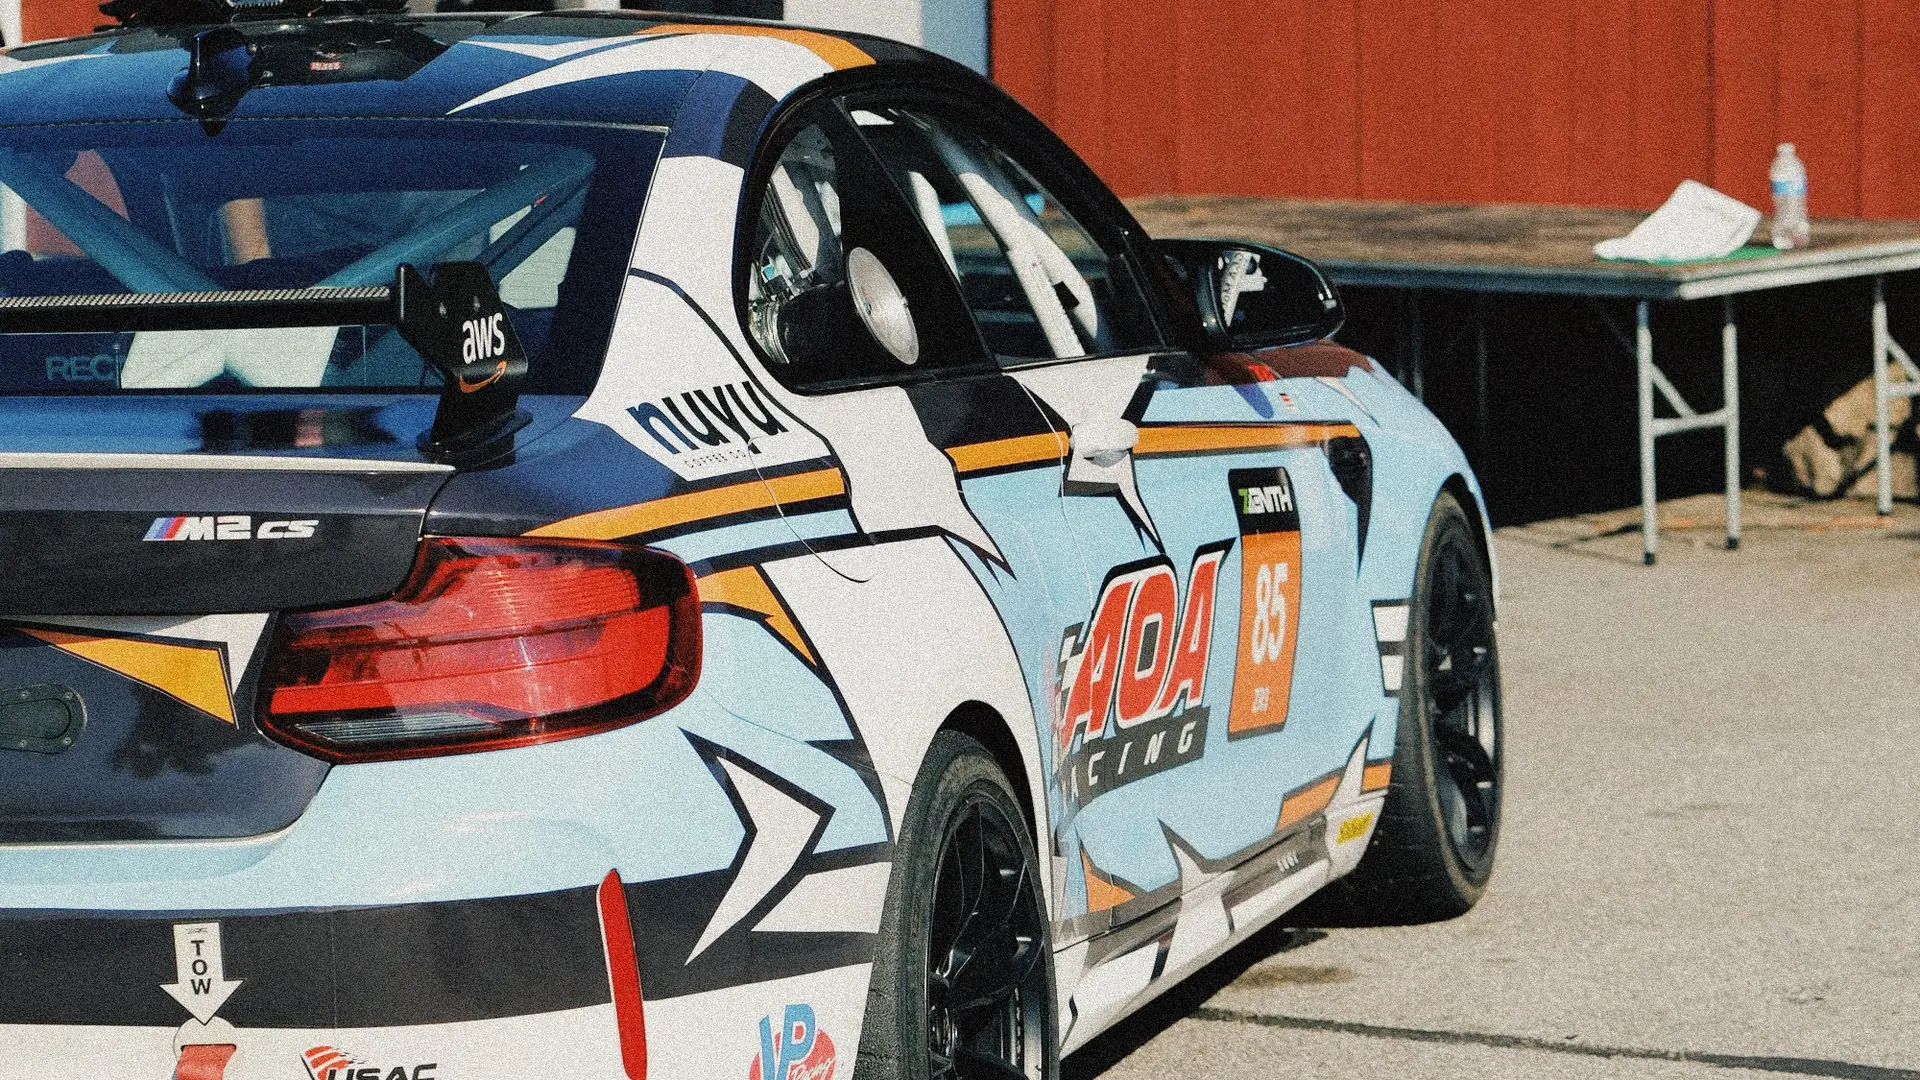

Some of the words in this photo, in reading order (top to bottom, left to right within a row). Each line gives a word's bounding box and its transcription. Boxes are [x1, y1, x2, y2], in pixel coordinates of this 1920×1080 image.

[462, 312, 505, 365] aws
[625, 381, 789, 455] nuyu
[172, 515, 251, 541] M2
[256, 520, 319, 539] CS
[1251, 561, 1289, 665] 85
[1062, 549, 1226, 757] AOA
[190, 939, 212, 996] TOW
